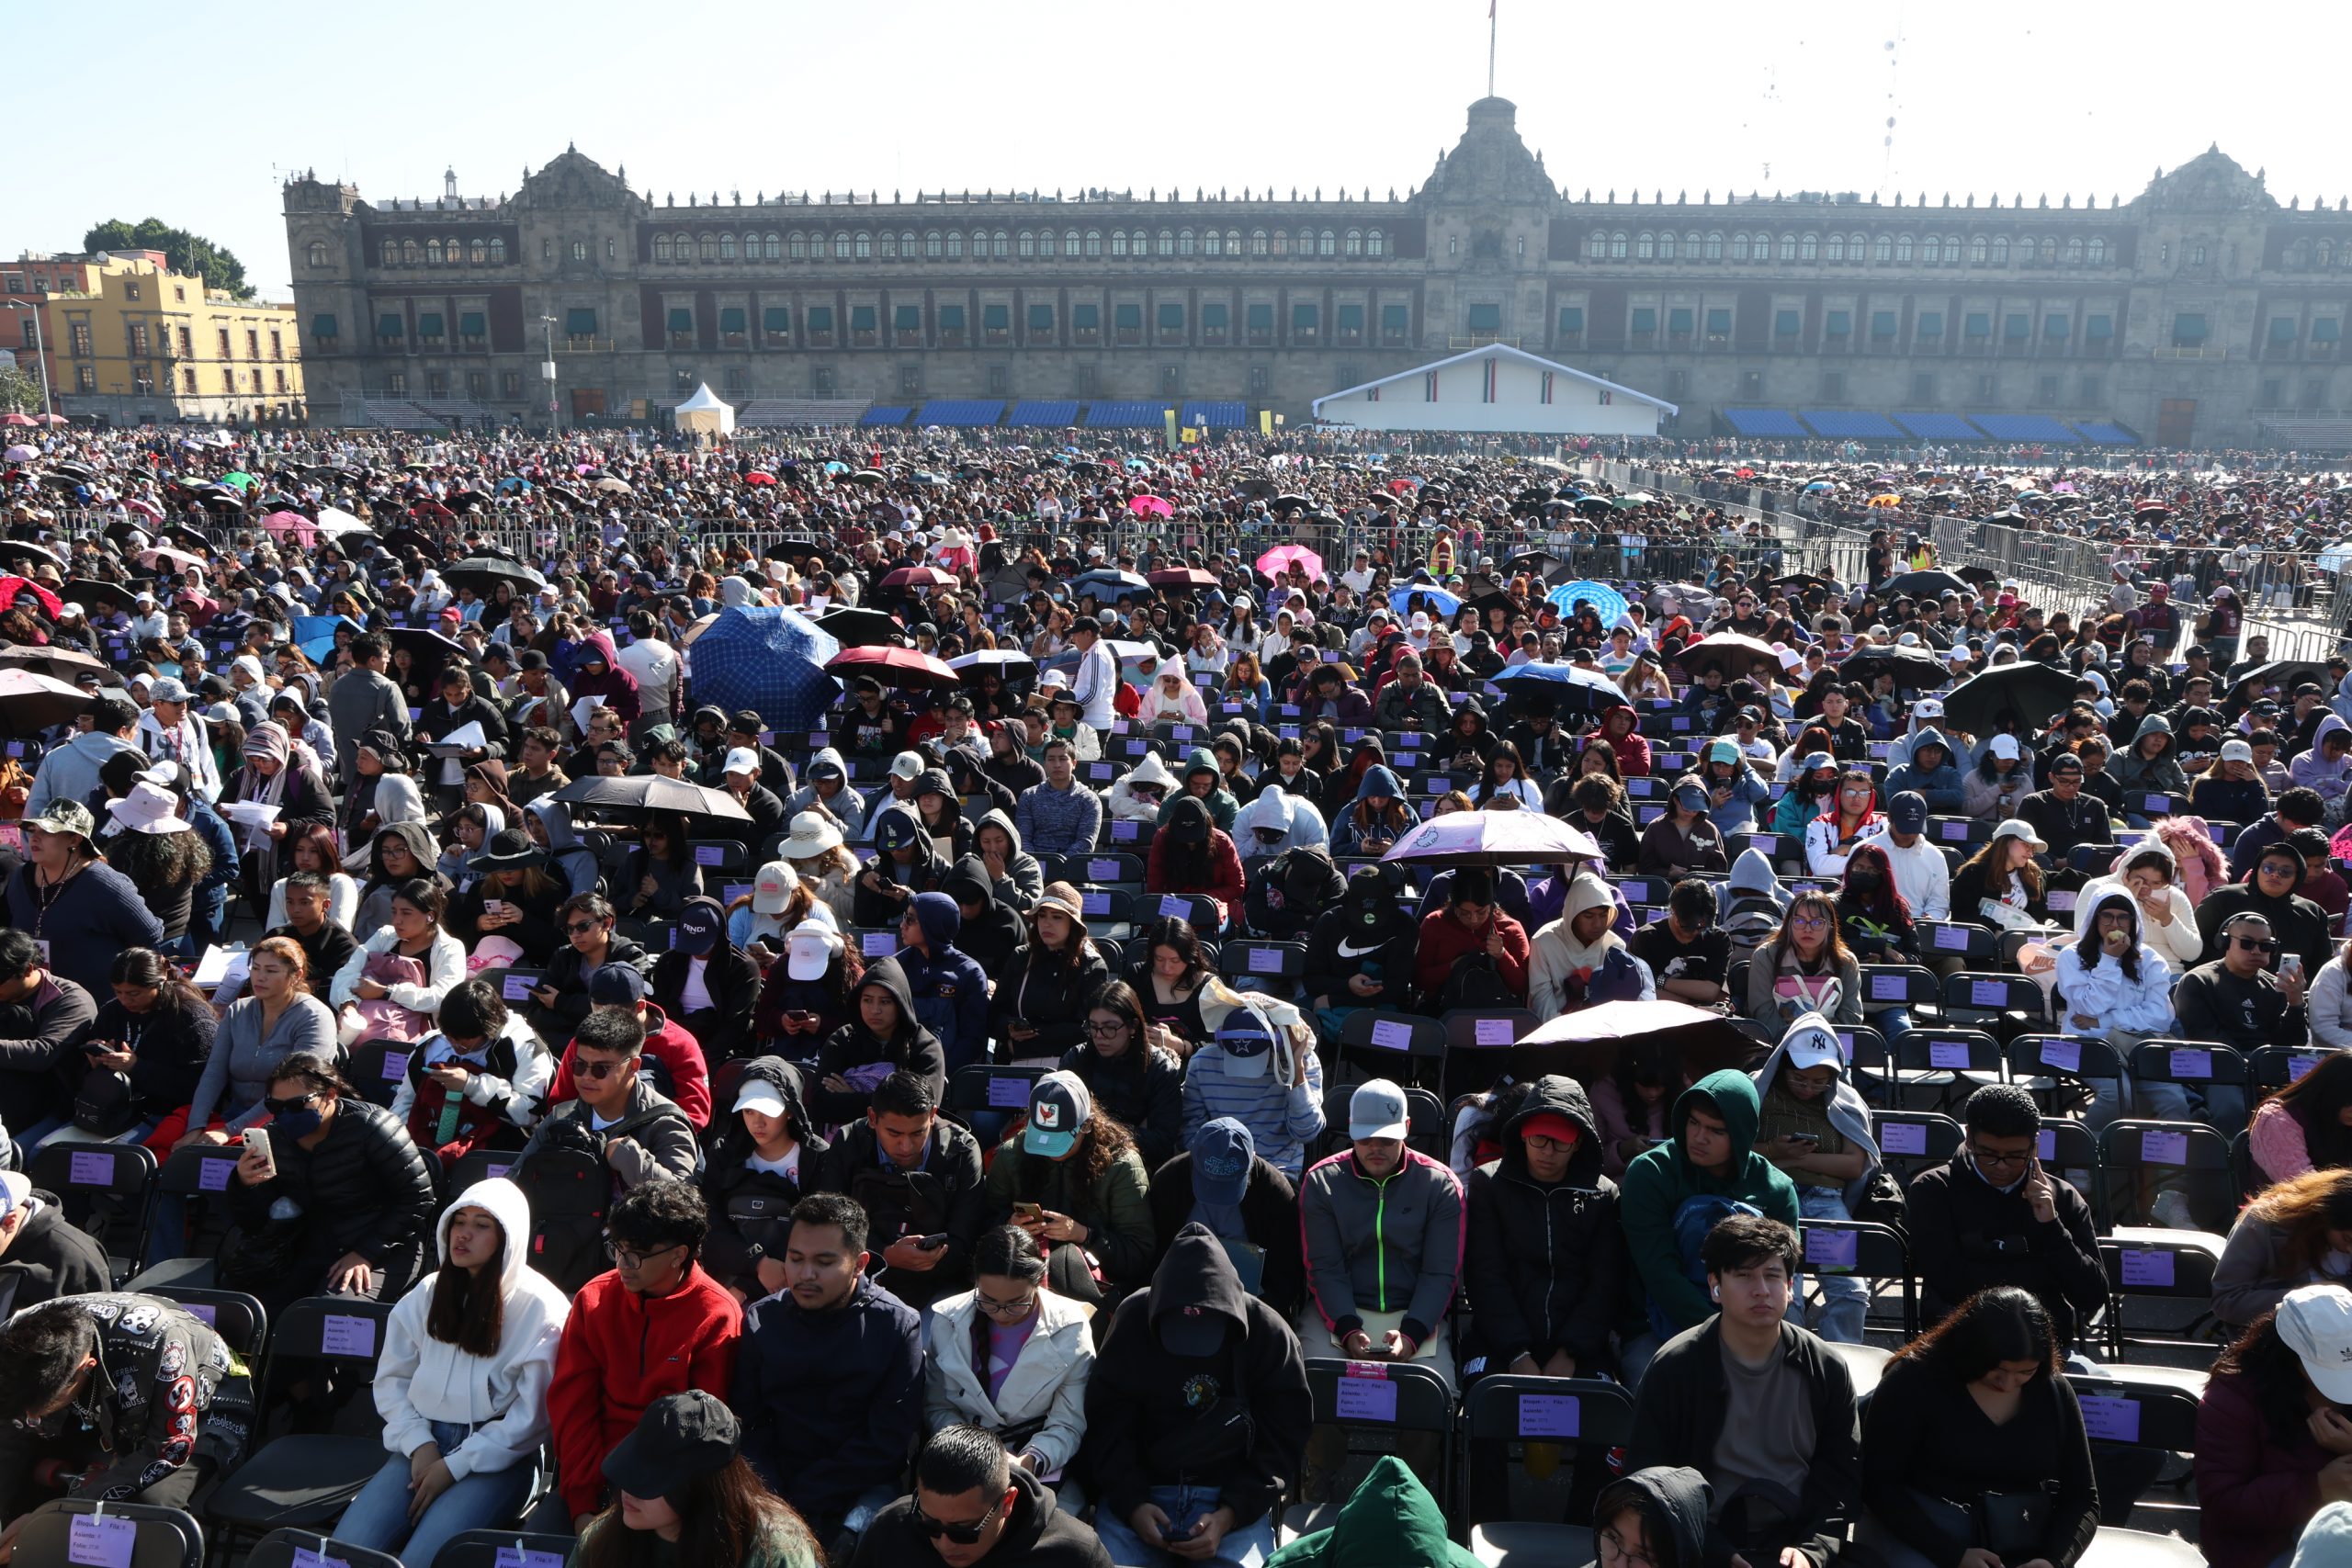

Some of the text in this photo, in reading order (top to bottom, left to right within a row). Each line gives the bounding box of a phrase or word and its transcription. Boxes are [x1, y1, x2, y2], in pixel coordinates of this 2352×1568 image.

[683, 922, 707, 933] FENDI
[2031, 955, 2056, 968] NIKE
[1812, 1033, 1826, 1050] NY
[121, 1396, 148, 1410] ABUSE
